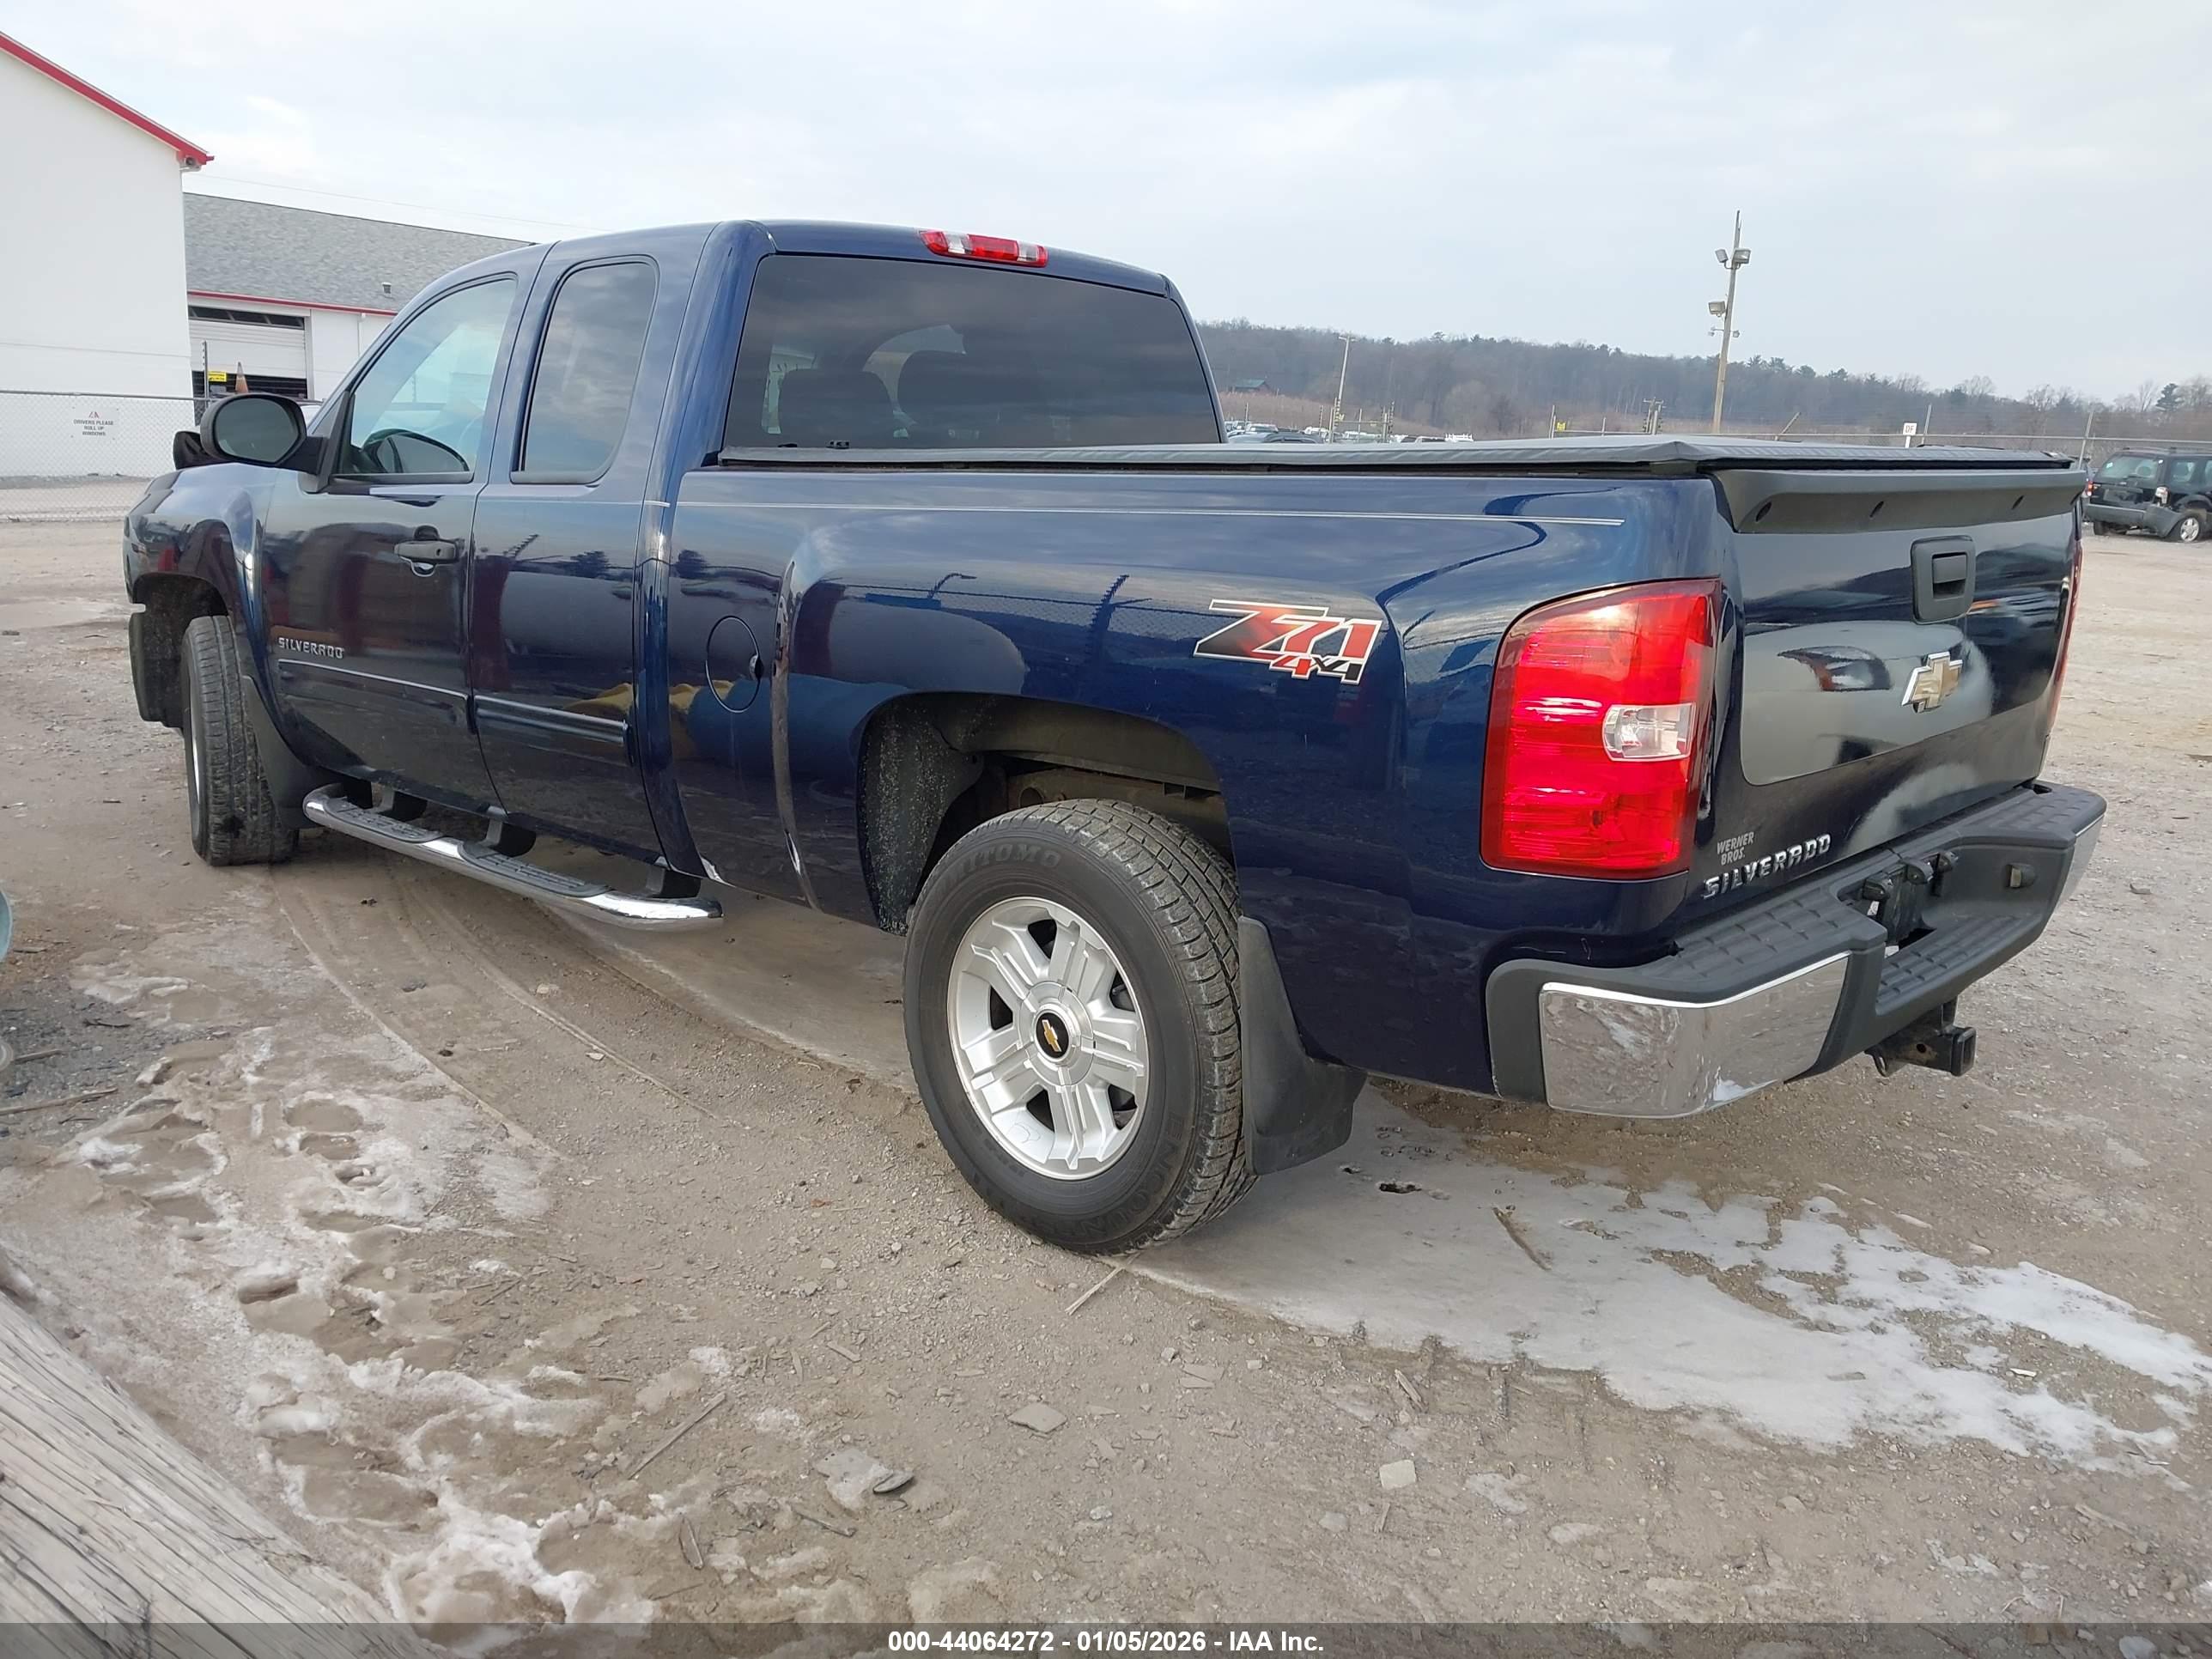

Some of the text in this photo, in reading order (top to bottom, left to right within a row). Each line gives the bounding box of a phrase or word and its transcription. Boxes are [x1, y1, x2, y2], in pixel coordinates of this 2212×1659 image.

[1193, 599, 1382, 665] Z71
[277, 636, 344, 659] SILVERADO
[1717, 830, 1755, 855] WERNER
[1702, 833, 1831, 899] SILVERADO
[1721, 846, 1746, 866] BROS.
